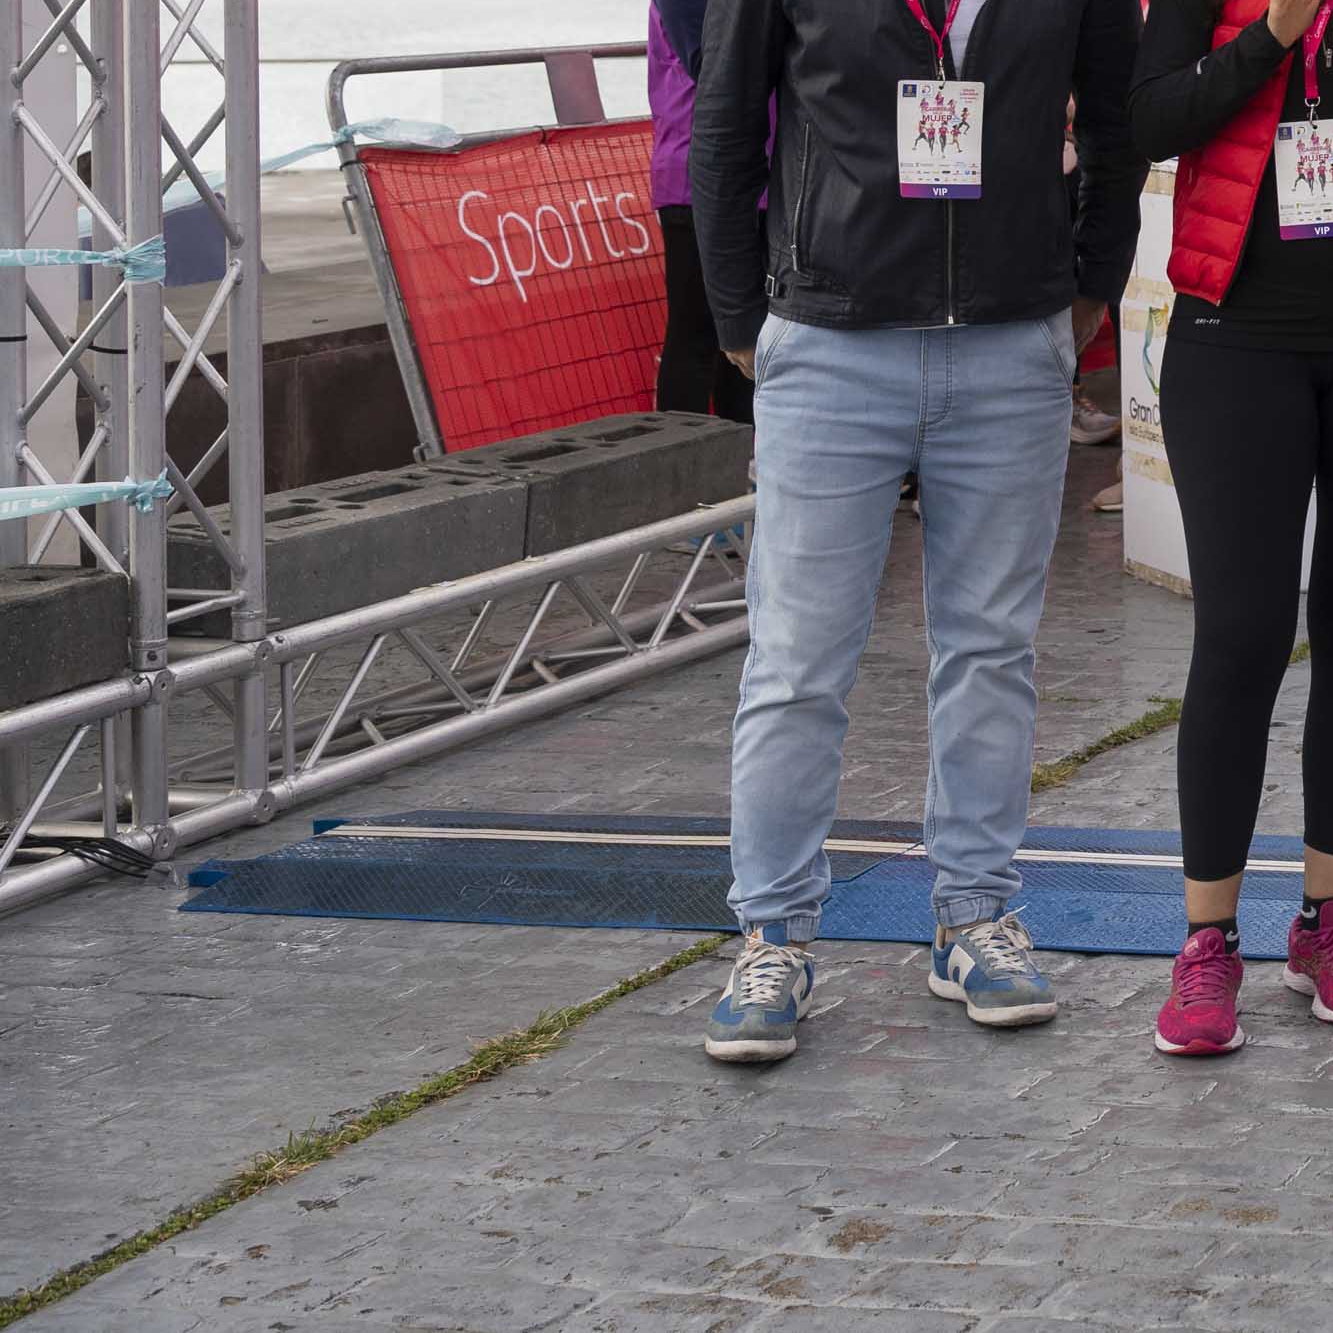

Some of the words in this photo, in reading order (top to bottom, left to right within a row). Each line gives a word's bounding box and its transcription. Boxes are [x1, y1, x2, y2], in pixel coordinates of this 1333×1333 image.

[922, 114, 953, 122] MUJER
[1300, 153, 1330, 163] MUJER
[932, 187, 948, 196] VIP
[1314, 226, 1330, 235] VIP
[457, 179, 650, 303] Sports
